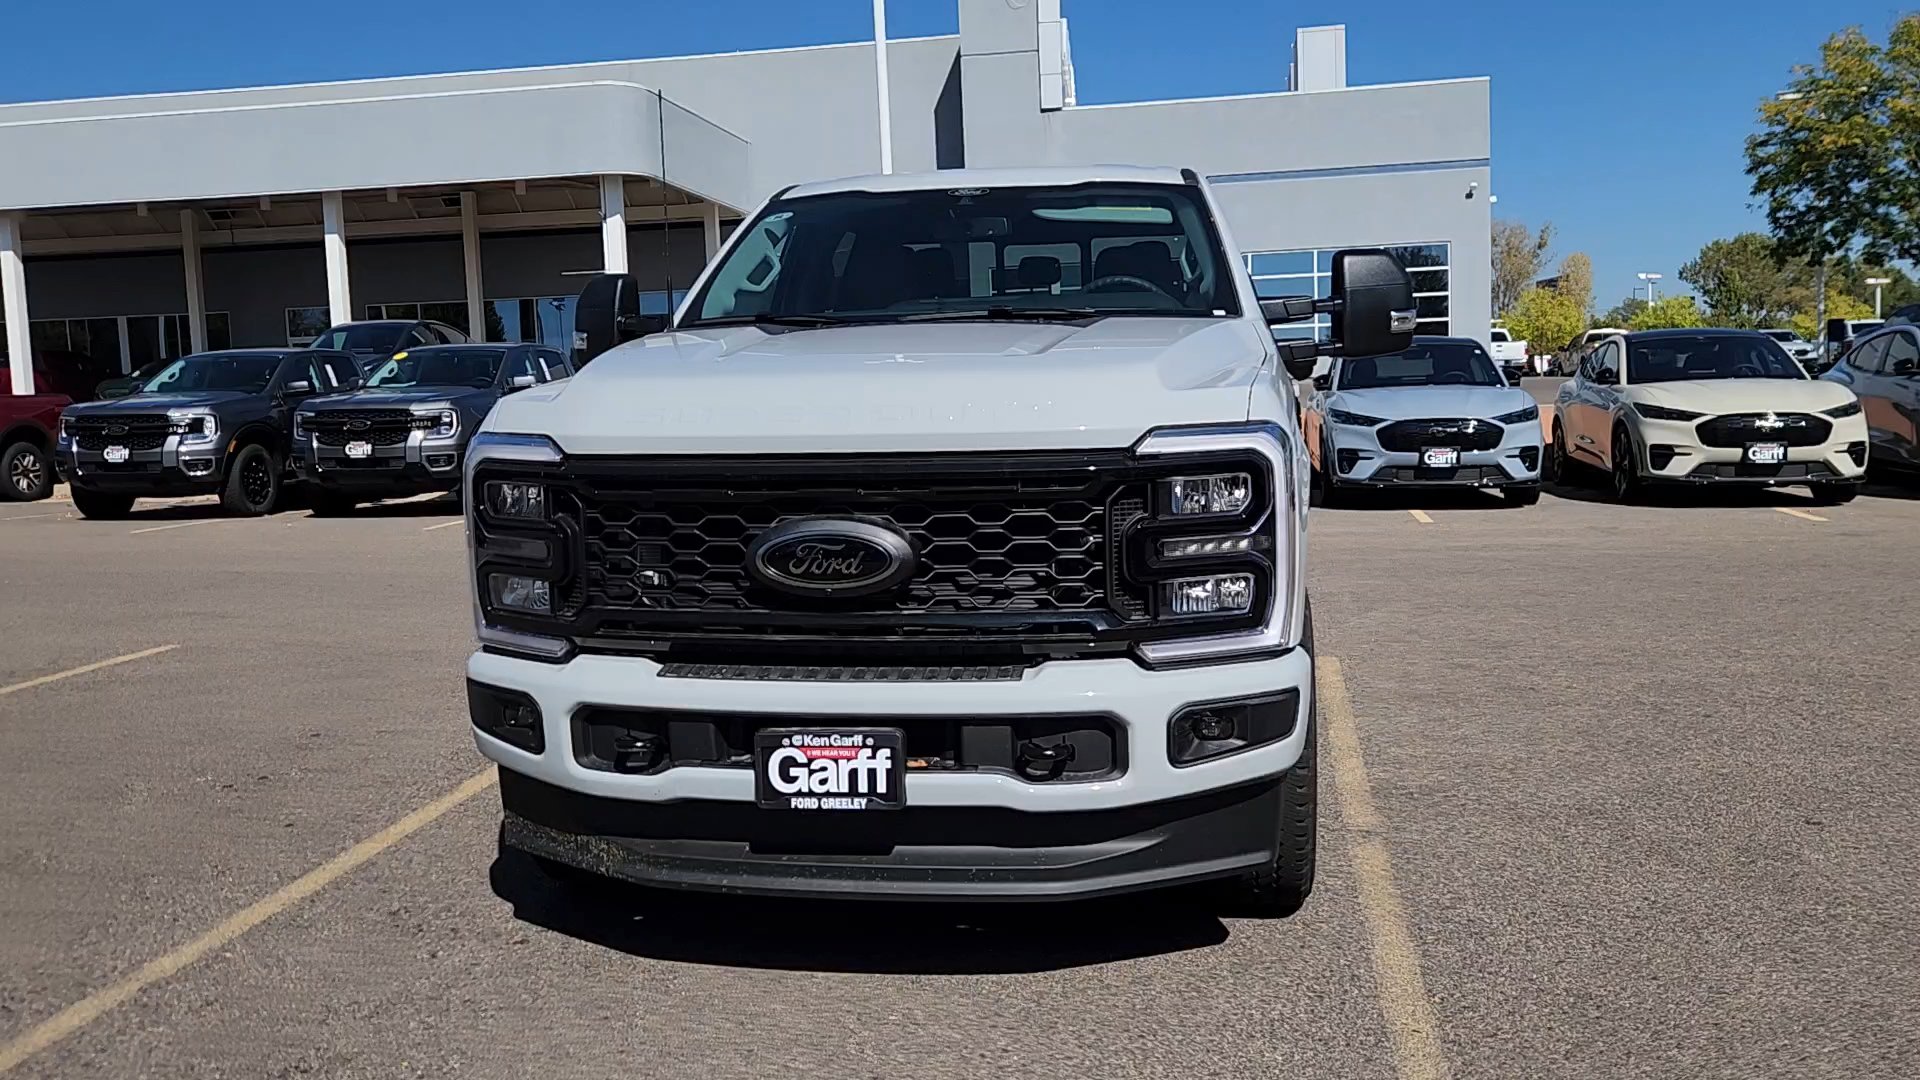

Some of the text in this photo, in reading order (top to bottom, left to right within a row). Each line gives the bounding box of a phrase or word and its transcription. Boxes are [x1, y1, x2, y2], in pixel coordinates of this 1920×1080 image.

[1424, 450, 1457, 464] Garff
[1748, 446, 1784, 460] Garff
[788, 543, 865, 574] Ford
[803, 734, 863, 746] Ken Garff
[812, 749, 851, 757] WE HEAR YOU
[768, 747, 891, 793] Garff
[791, 798, 868, 809] FORD GREELEY
